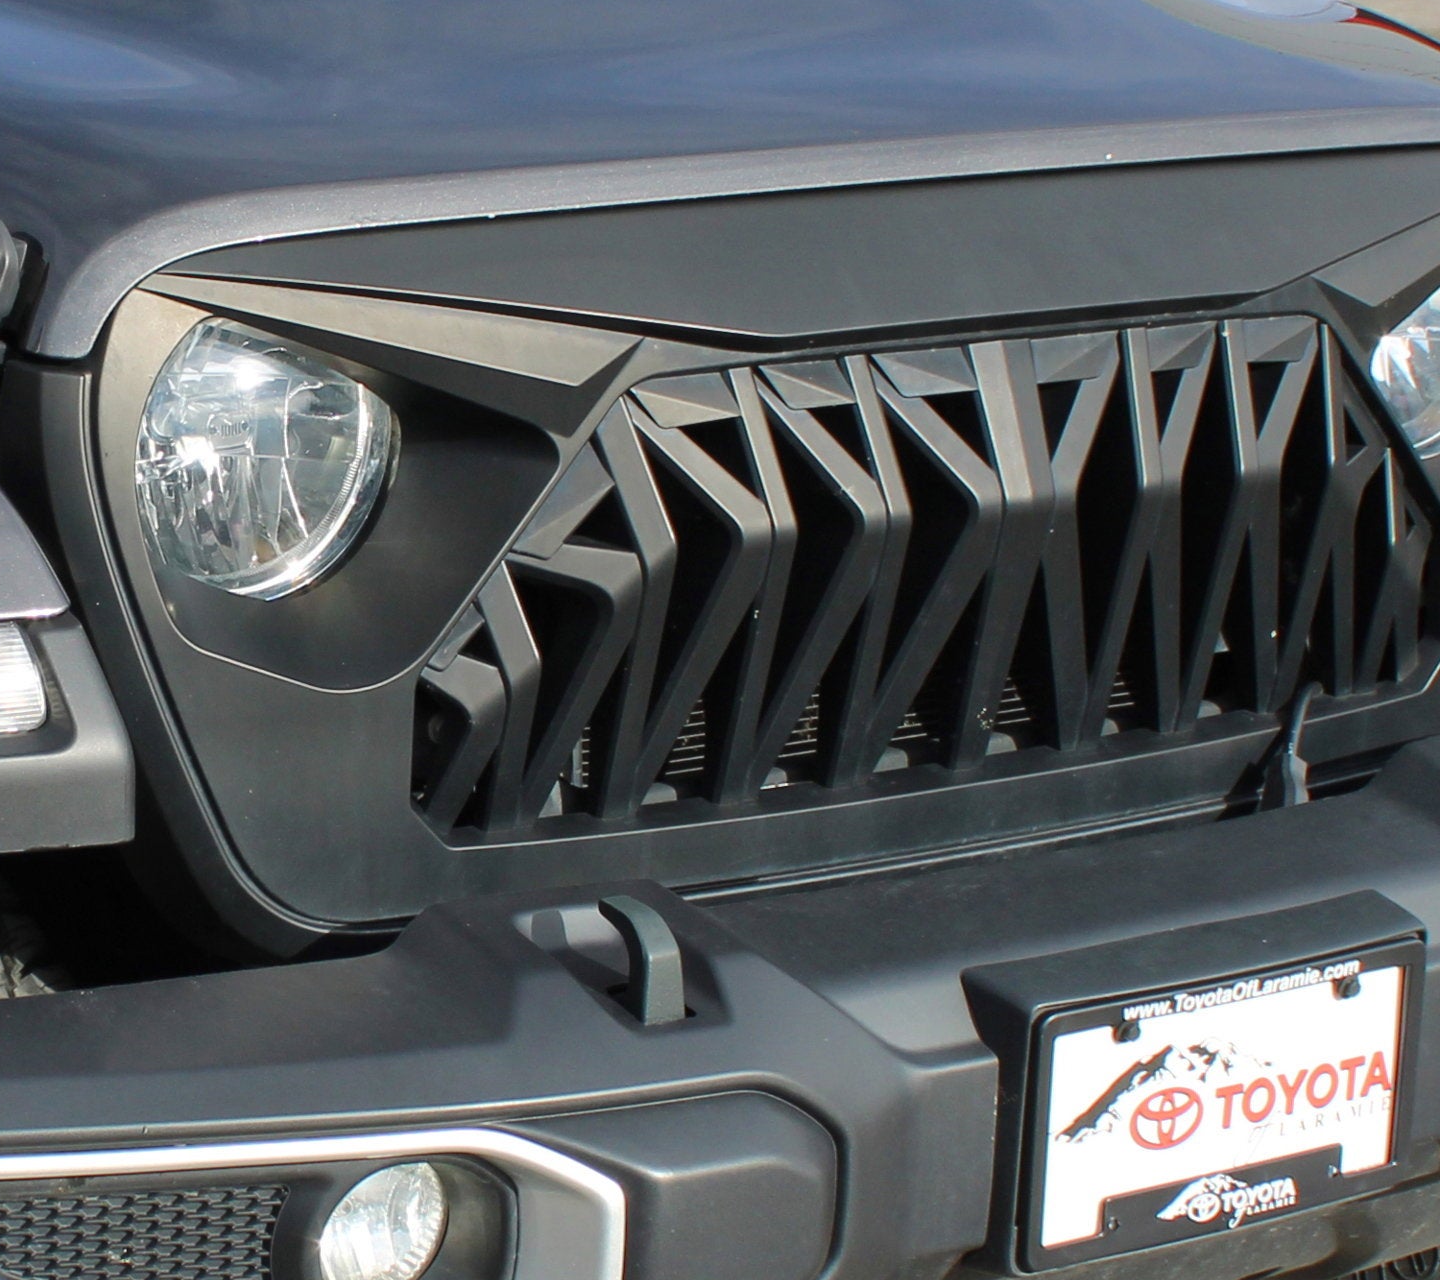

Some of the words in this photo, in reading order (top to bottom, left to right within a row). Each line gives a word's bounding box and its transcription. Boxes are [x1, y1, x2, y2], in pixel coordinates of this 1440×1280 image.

[1123, 959, 1362, 1021] www.ToyotaOfLaramie.com
[1215, 1051, 1392, 1130] TOYOTA
[1221, 1176, 1297, 1213] TOYOTA
